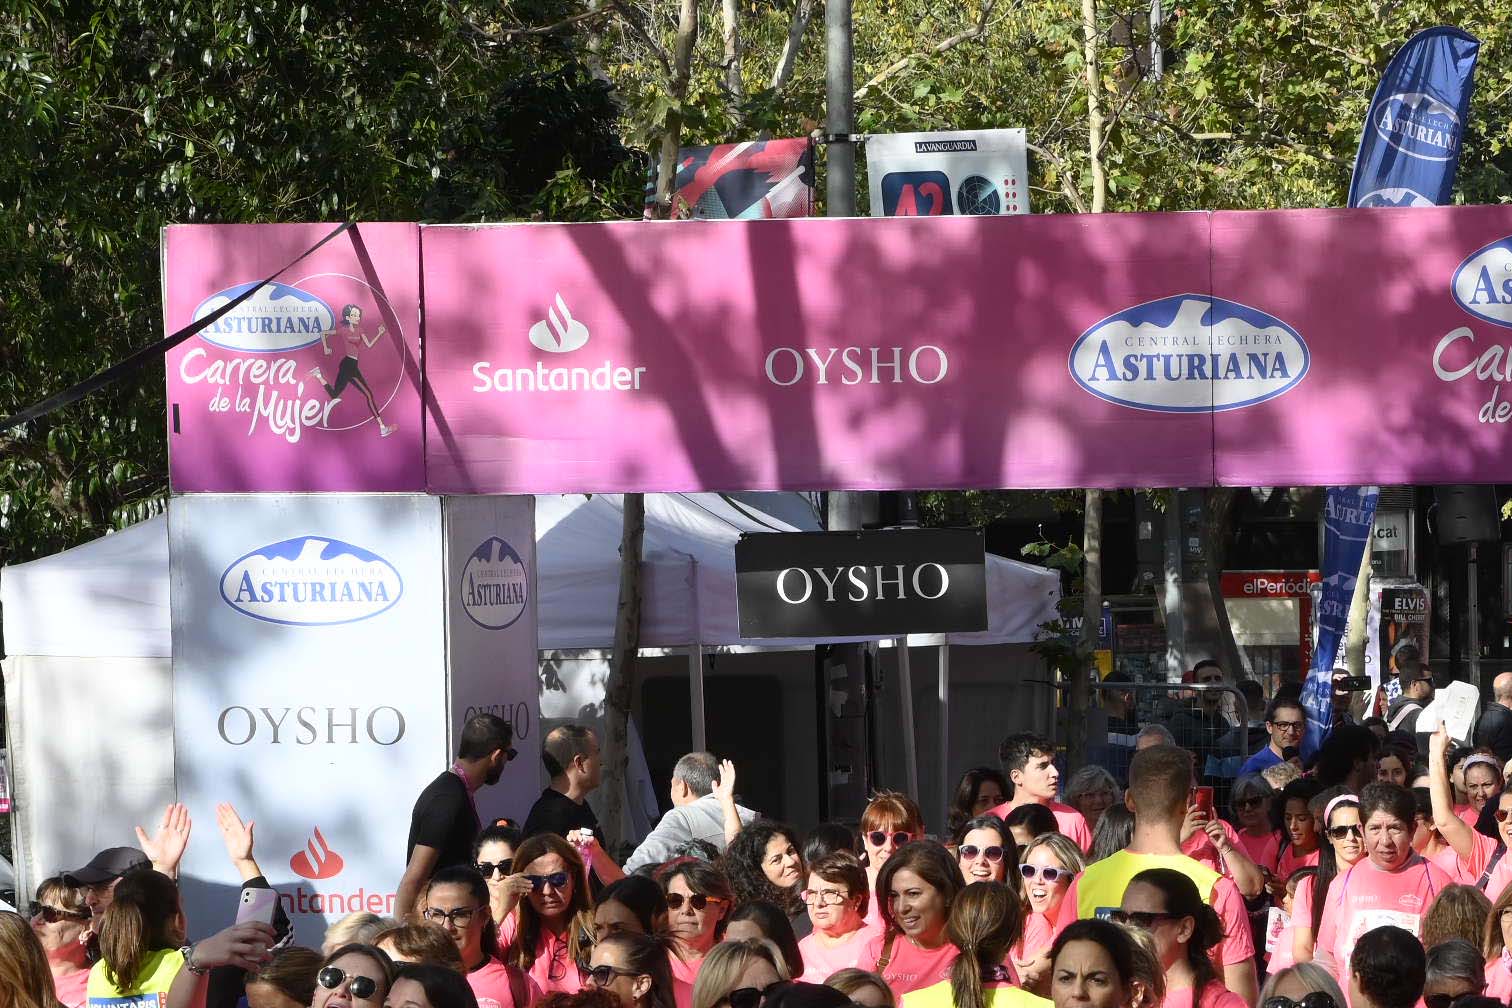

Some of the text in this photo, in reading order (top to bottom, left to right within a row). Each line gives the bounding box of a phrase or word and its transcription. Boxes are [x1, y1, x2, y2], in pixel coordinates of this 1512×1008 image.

[926, 140, 976, 151] VANGUARDIA
[1124, 333, 1283, 348] CENTRAL LECHERA
[179, 347, 297, 385] Carrera
[472, 358, 647, 393] Santander
[764, 344, 949, 387] OYSHO
[1087, 339, 1292, 383] ASTURIANA
[208, 380, 343, 444] de la Mujer
[1478, 384, 1512, 424] de
[233, 569, 390, 604] ASTURIANA
[466, 571, 525, 608] ASTURIANA
[775, 561, 950, 605] OYSHO
[1394, 597, 1425, 610] ELVIS
[217, 704, 407, 747] OYSHO
[278, 886, 398, 915] ntander
